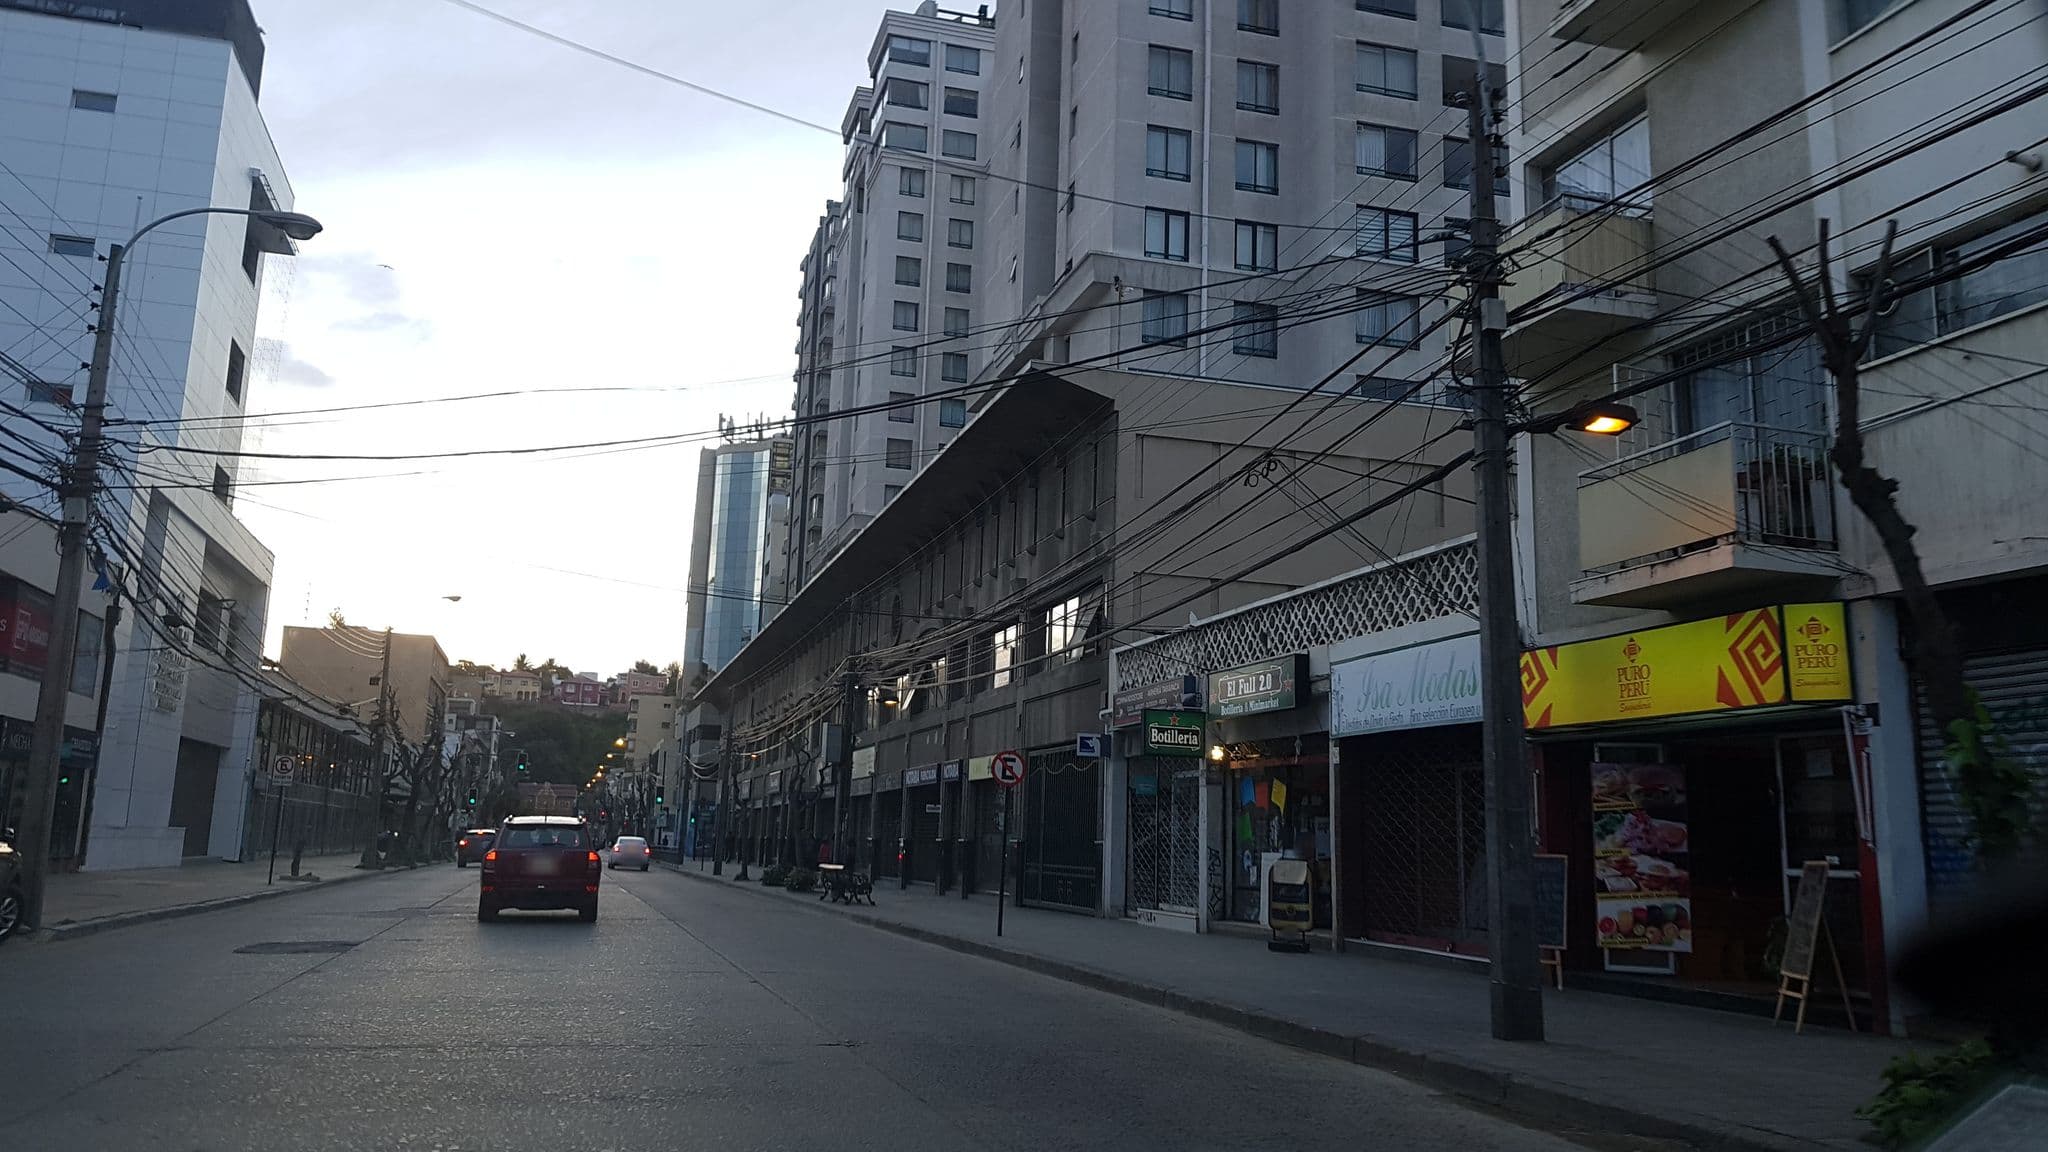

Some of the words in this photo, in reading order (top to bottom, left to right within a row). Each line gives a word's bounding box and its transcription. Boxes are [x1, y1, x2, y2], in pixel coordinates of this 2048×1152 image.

[1794, 643, 1839, 657] PURO
[1357, 660, 1393, 713] Isa
[1397, 648, 1480, 704] Modas
[1616, 664, 1651, 683] PURO
[1227, 680, 1236, 697] El
[1238, 676, 1256, 695] Full
[1259, 673, 1272, 692] 2.0
[1150, 728, 1199, 745] Botillería
